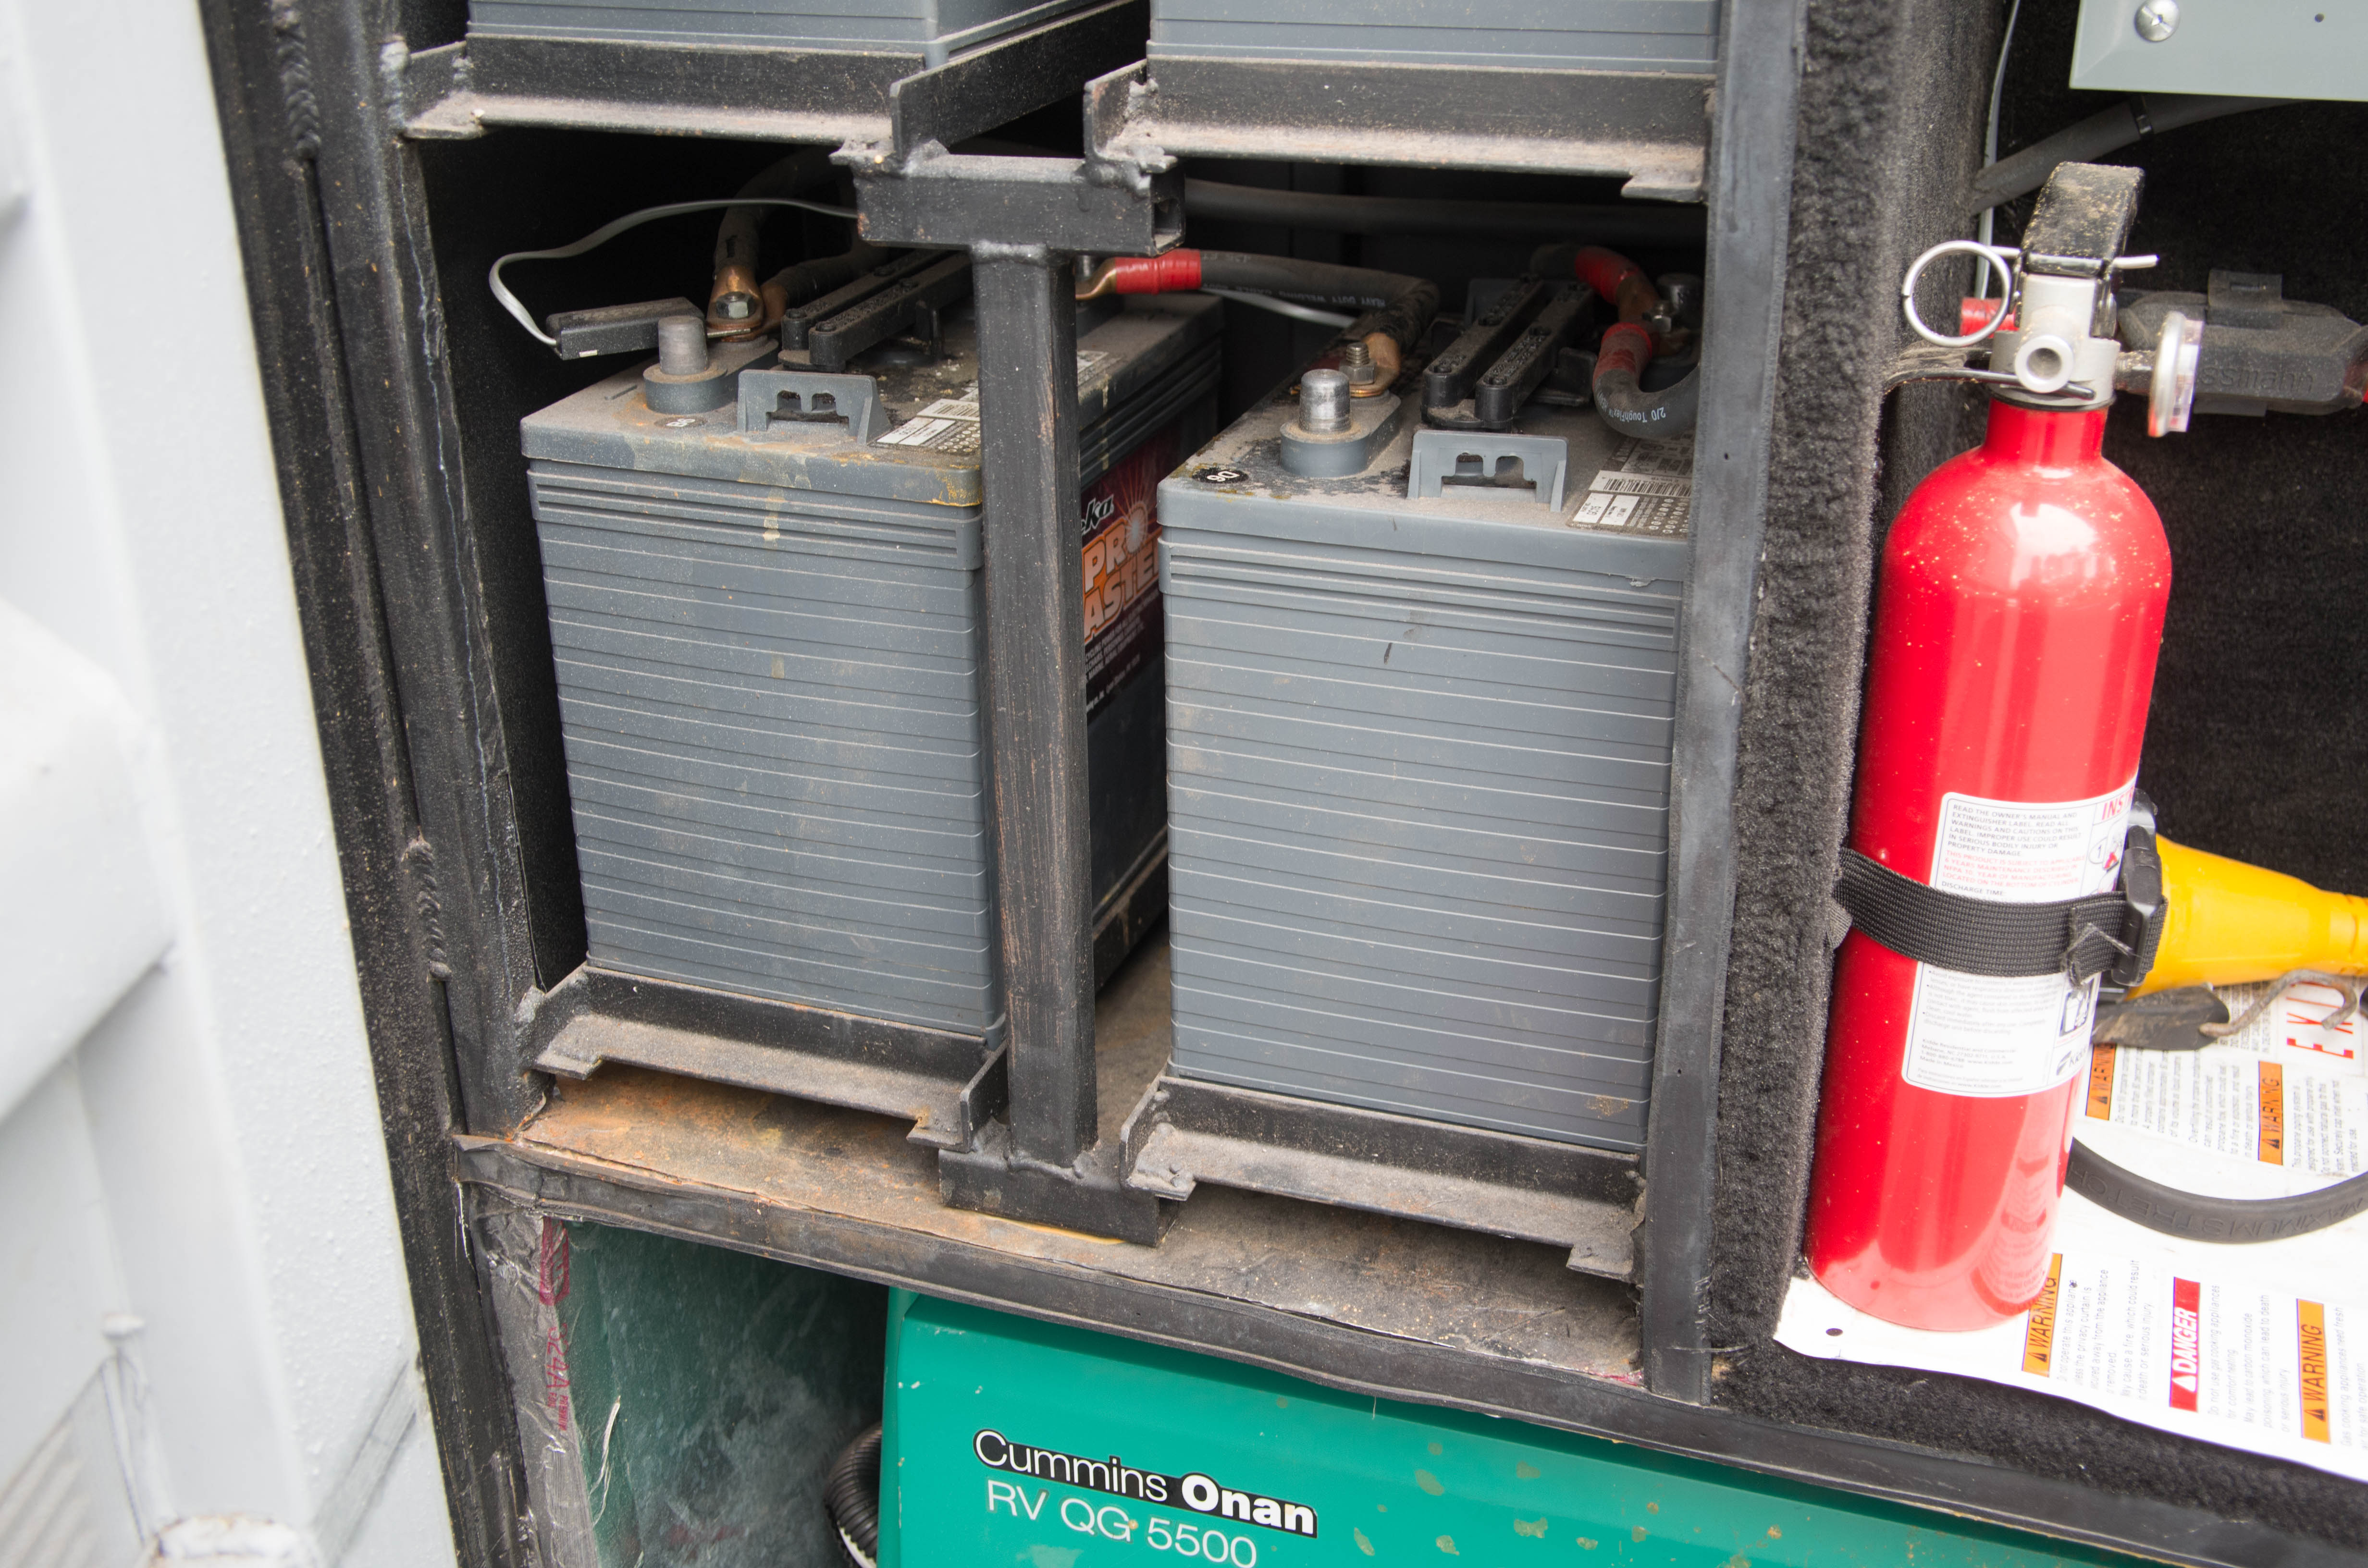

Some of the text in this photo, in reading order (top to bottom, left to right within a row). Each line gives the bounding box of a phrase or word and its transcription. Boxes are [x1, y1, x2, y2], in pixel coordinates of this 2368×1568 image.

[1651, 406, 1666, 421] 2/0
[1082, 495, 1114, 535] eka
[1084, 532, 1159, 642] ASTE
[1952, 812, 2007, 826] EXTINGUISHER
[1953, 804, 1973, 813] READ
[1976, 808, 1989, 816] THE
[1992, 811, 2026, 820] OWNER'S
[1951, 819, 1992, 832] WARNINGS
[1959, 836, 1989, 845] SERIOUS
[1977, 832, 2015, 841] IMPROPER
[1946, 850, 1961, 858] THIS
[1963, 854, 1998, 864] PRODUCT
[1948, 842, 1985, 853] PROPERTY
[1943, 872, 1975, 883] LOCATED
[1977, 863, 2030, 873] MAINTENANCE
[1942, 881, 1983, 894] DISCHARGE
[2262, 1077, 2280, 1133] WARNNG
[2129, 1260, 2140, 1284] result
[2097, 1269, 2109, 1306] appliance
[2127, 1285, 2137, 1305] could
[2029, 1277, 2057, 1348] WARNING
[2079, 1296, 2090, 1322] curtain
[2095, 1308, 2105, 1320] the
[2208, 1285, 2221, 1328] appliances
[2258, 1295, 2269, 1315] death
[2062, 1319, 2073, 1334] this
[2125, 1307, 2135, 1329] which
[2332, 1307, 2344, 1327] fresh
[2077, 1325, 2090, 1352] privacy
[2092, 1322, 2104, 1339] from
[2172, 1307, 2197, 1374] DANGER
[2243, 1312, 2253, 1351] monoxide
[2259, 1327, 2269, 1343] lead
[2139, 1327, 2151, 1357] serious
[2209, 1329, 2221, 1358] cooking
[545, 1323, 570, 1389] 324A
[2092, 1342, 2104, 1364] away
[2260, 1346, 2269, 1361] can
[2301, 1324, 2325, 1402] WARNING
[2122, 1358, 2133, 1383] cause
[2139, 1360, 2149, 1369] or
[2243, 1354, 2253, 1378] carbon
[2259, 1364, 2270, 1384] which
[2337, 1348, 2349, 1392] appliances
[2209, 1372, 2220, 1386] use
[2209, 1389, 2220, 1402] not
[2226, 1375, 2236, 1406] comfort
[2244, 1388, 2255, 1404] lead
[2280, 1393, 2290, 1421] serious
[2339, 1395, 2353, 1429] cooking
[2356, 1406, 2368, 1423] safe
[975, 1429, 1314, 1534] Cummins Onan
[987, 1479, 1257, 1568] RV QG 5500
